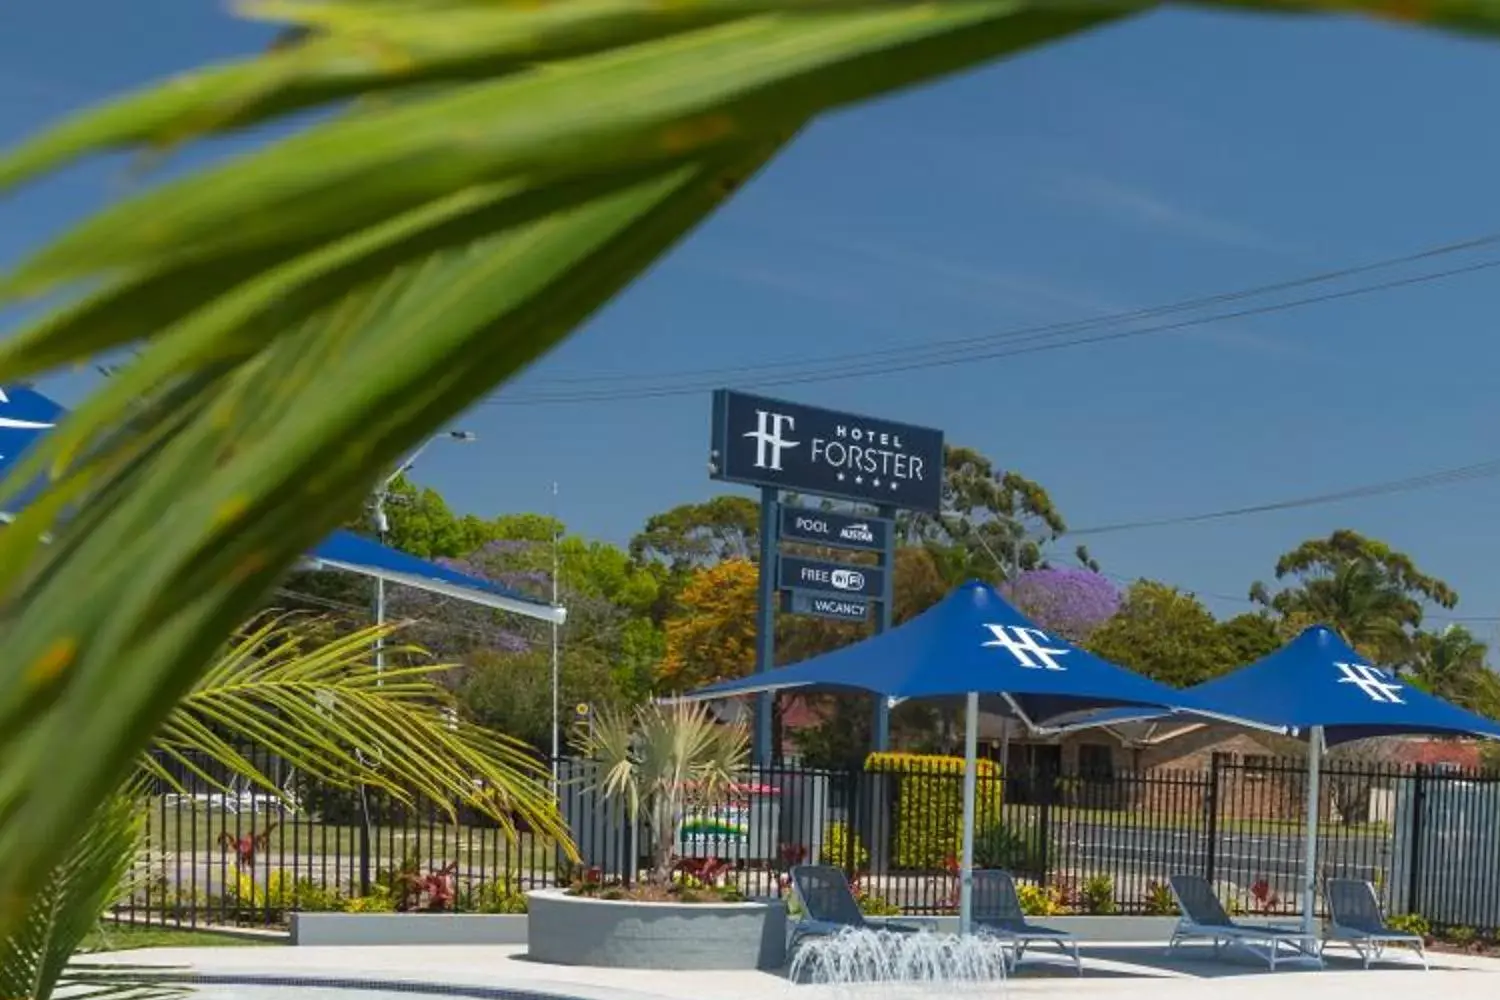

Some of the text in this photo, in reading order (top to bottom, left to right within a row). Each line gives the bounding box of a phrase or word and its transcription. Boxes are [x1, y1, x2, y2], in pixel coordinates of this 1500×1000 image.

[836, 425, 904, 448] HOTEL
[811, 438, 925, 482] FORSTER
[796, 517, 829, 534] POOL
[801, 567, 830, 583] FREE
[815, 600, 865, 616] VACANCY
